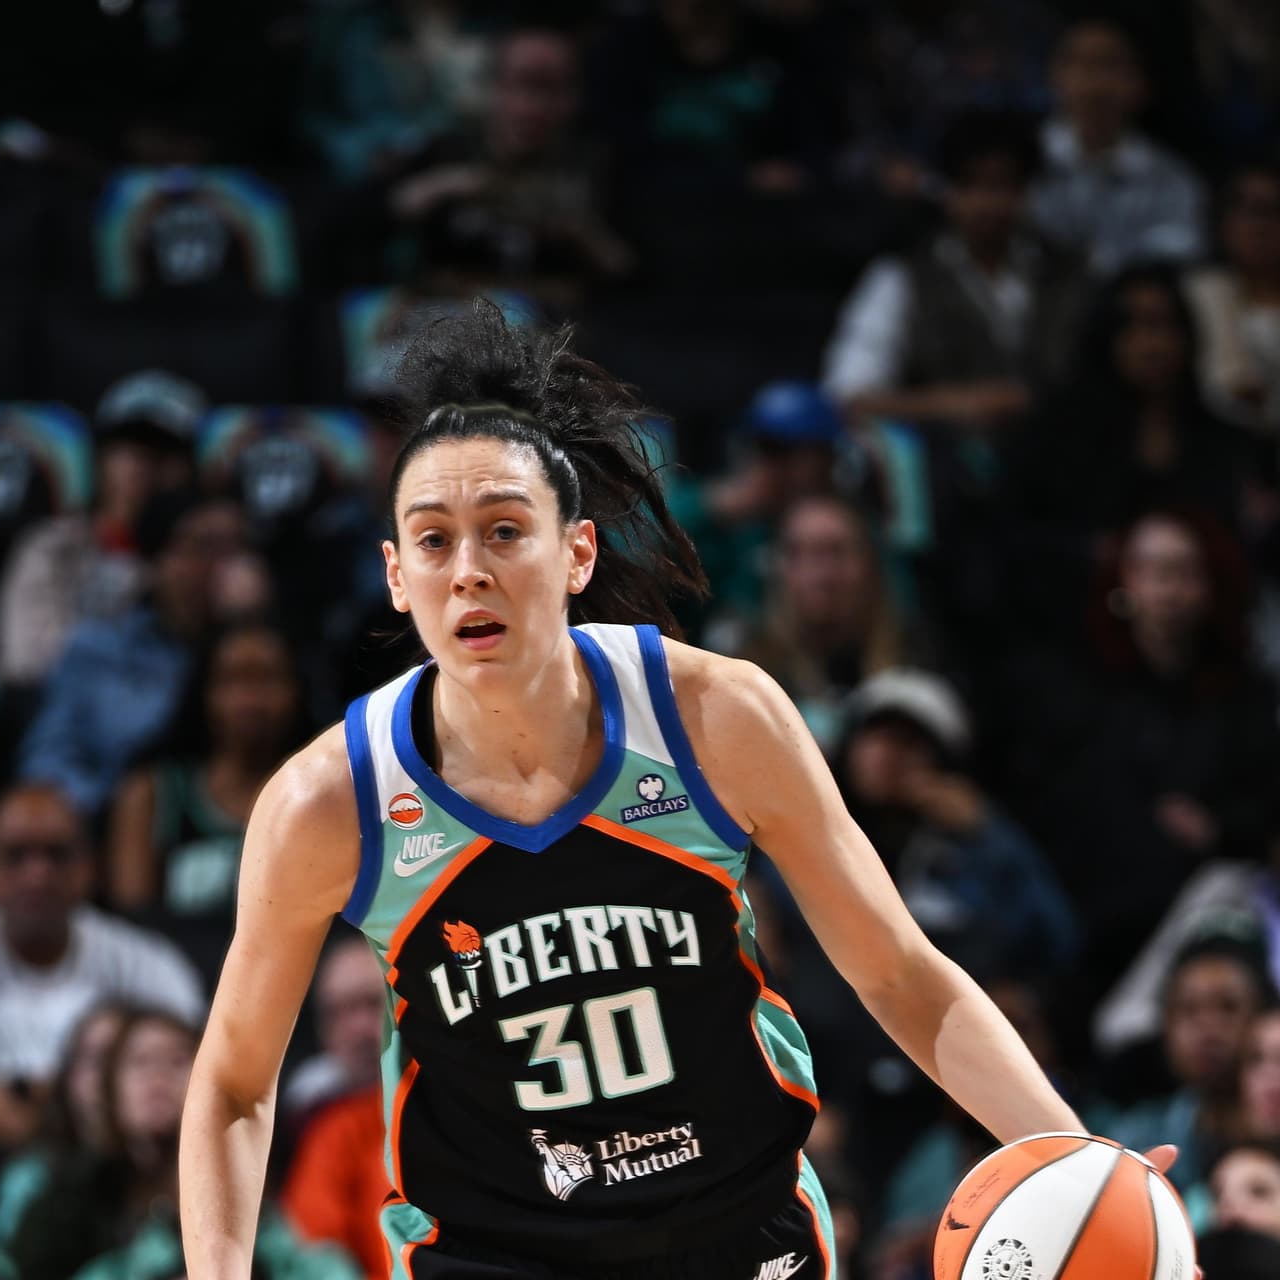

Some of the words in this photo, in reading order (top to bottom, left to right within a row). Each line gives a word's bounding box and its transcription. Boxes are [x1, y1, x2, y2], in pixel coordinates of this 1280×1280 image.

[624, 797, 687, 821] BARCLAYS
[402, 833, 446, 860] NIKE
[497, 986, 675, 1112] 30
[595, 1122, 692, 1161] Liberty
[602, 1138, 704, 1186] Mutual
